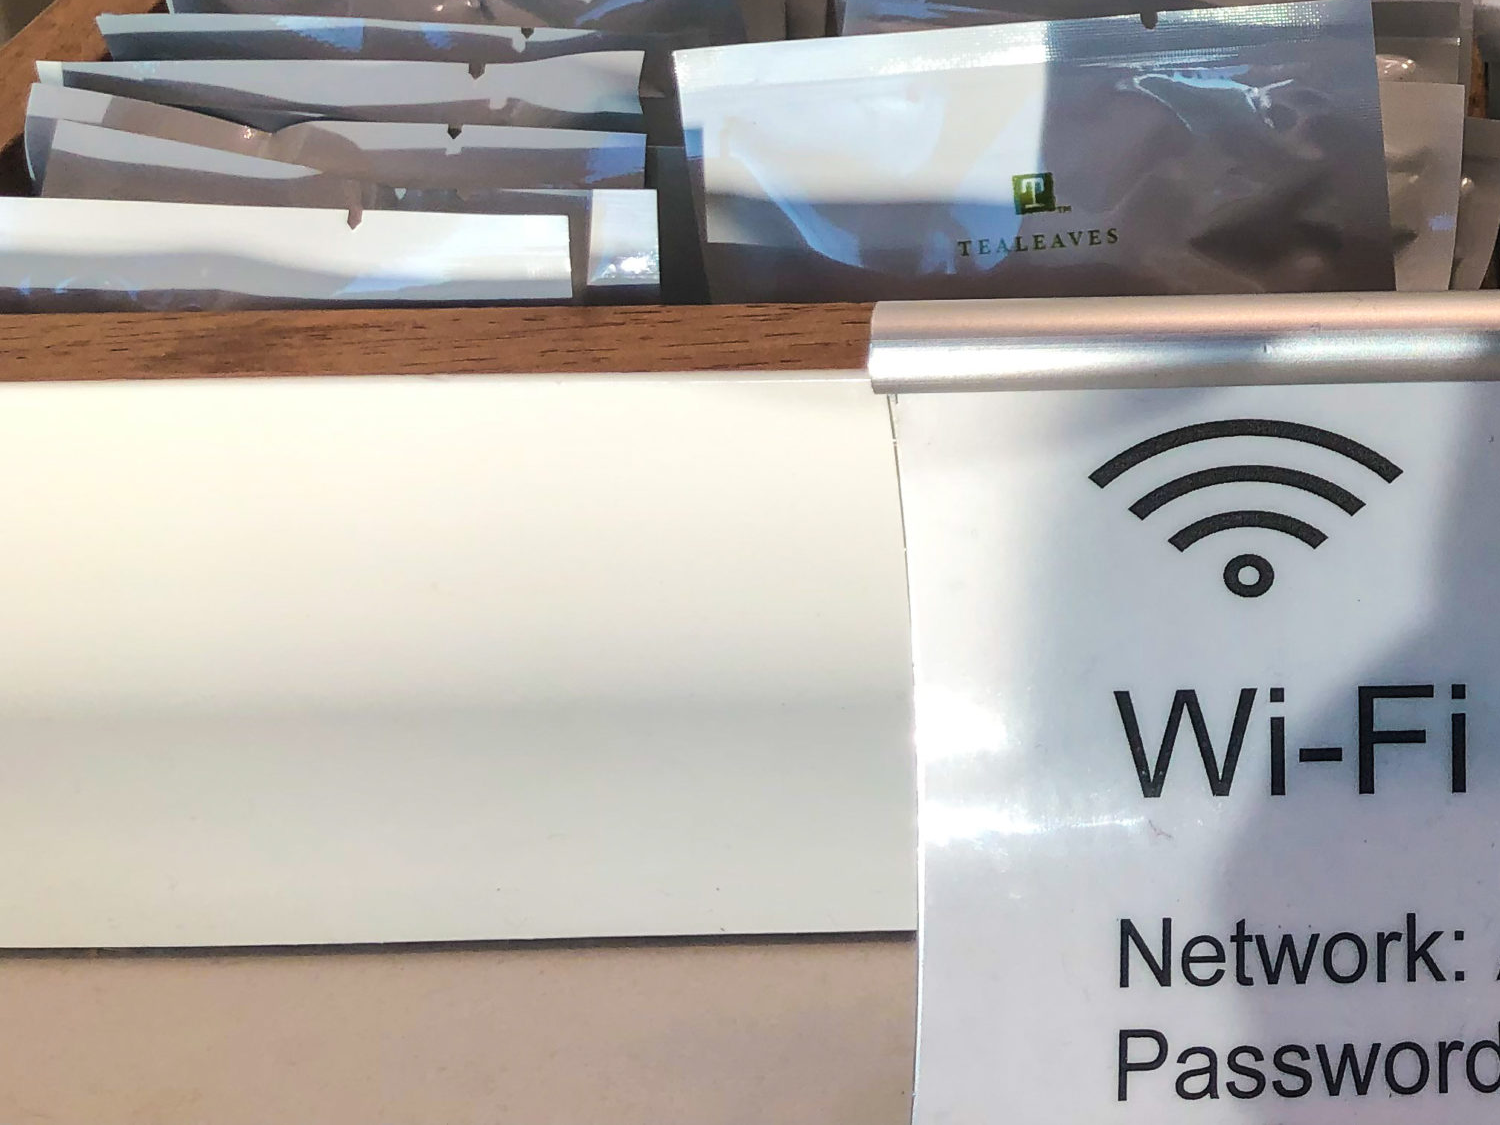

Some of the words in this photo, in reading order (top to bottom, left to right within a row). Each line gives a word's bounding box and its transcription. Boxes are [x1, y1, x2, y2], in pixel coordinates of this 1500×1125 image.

[957, 227, 1119, 257] TEALEAVES
[1113, 683, 1468, 798] Wi-Fi
[1118, 912, 1466, 988] Network:
